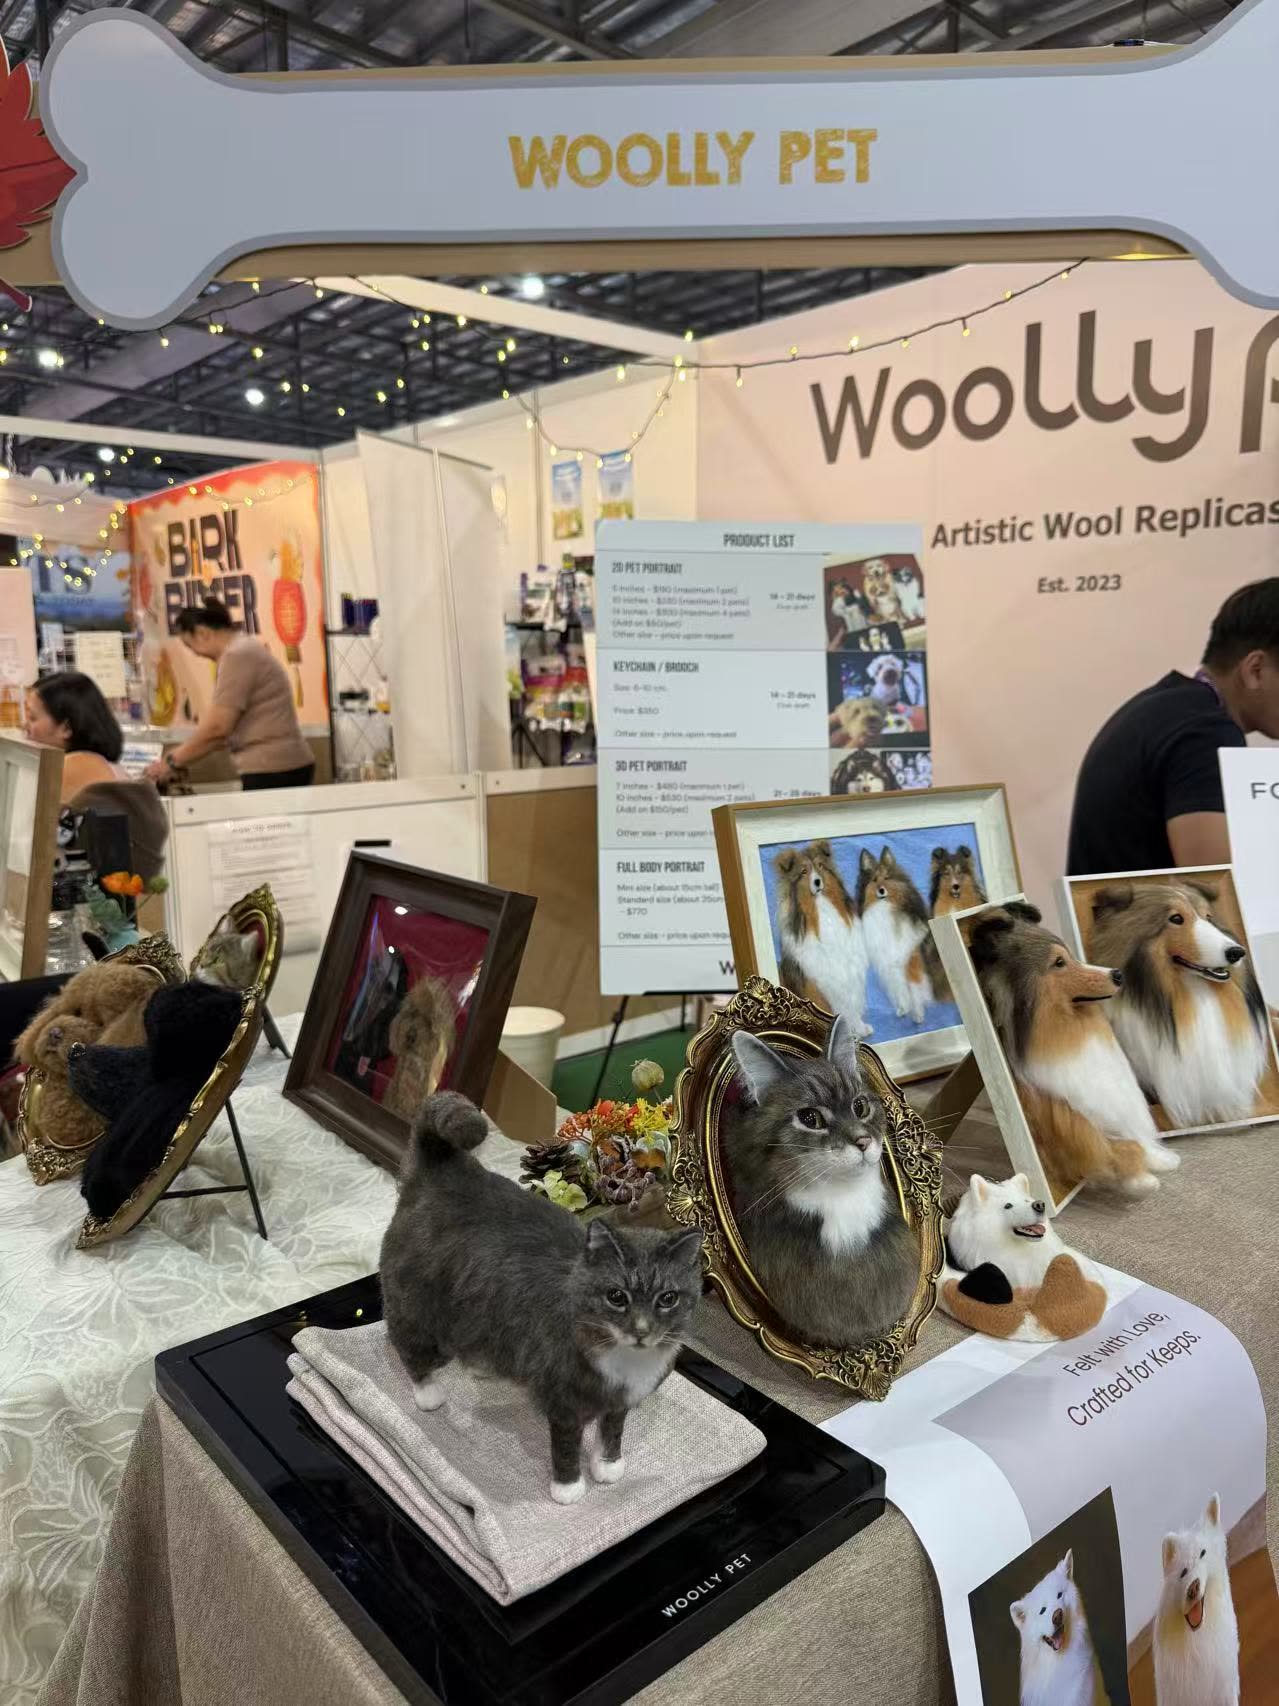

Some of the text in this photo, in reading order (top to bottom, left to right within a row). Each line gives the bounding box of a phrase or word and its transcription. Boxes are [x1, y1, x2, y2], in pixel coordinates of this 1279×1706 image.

[507, 128, 878, 190] WOOLLY PET
[810, 310, 1214, 464] Woolly
[723, 534, 794, 548] PRODUCT LIST
[931, 516, 1034, 548] Artistic
[1044, 506, 1123, 540] Wool
[625, 562, 641, 574] PET
[642, 562, 682, 574] PORTRAIT
[1037, 575, 1122, 593] Est. 2023
[613, 661, 656, 672] KEYCHAIN
[664, 661, 700, 672] BROOCH
[616, 761, 687, 771] 3D PET PORTRAIT
[617, 861, 705, 873] FULL BODY PORTRAIT
[1062, 1312, 1171, 1376] Felt with Love,
[1067, 1330, 1202, 1426] Crafted for Keeps.
[661, 1553, 751, 1617] WOOLLY PET
